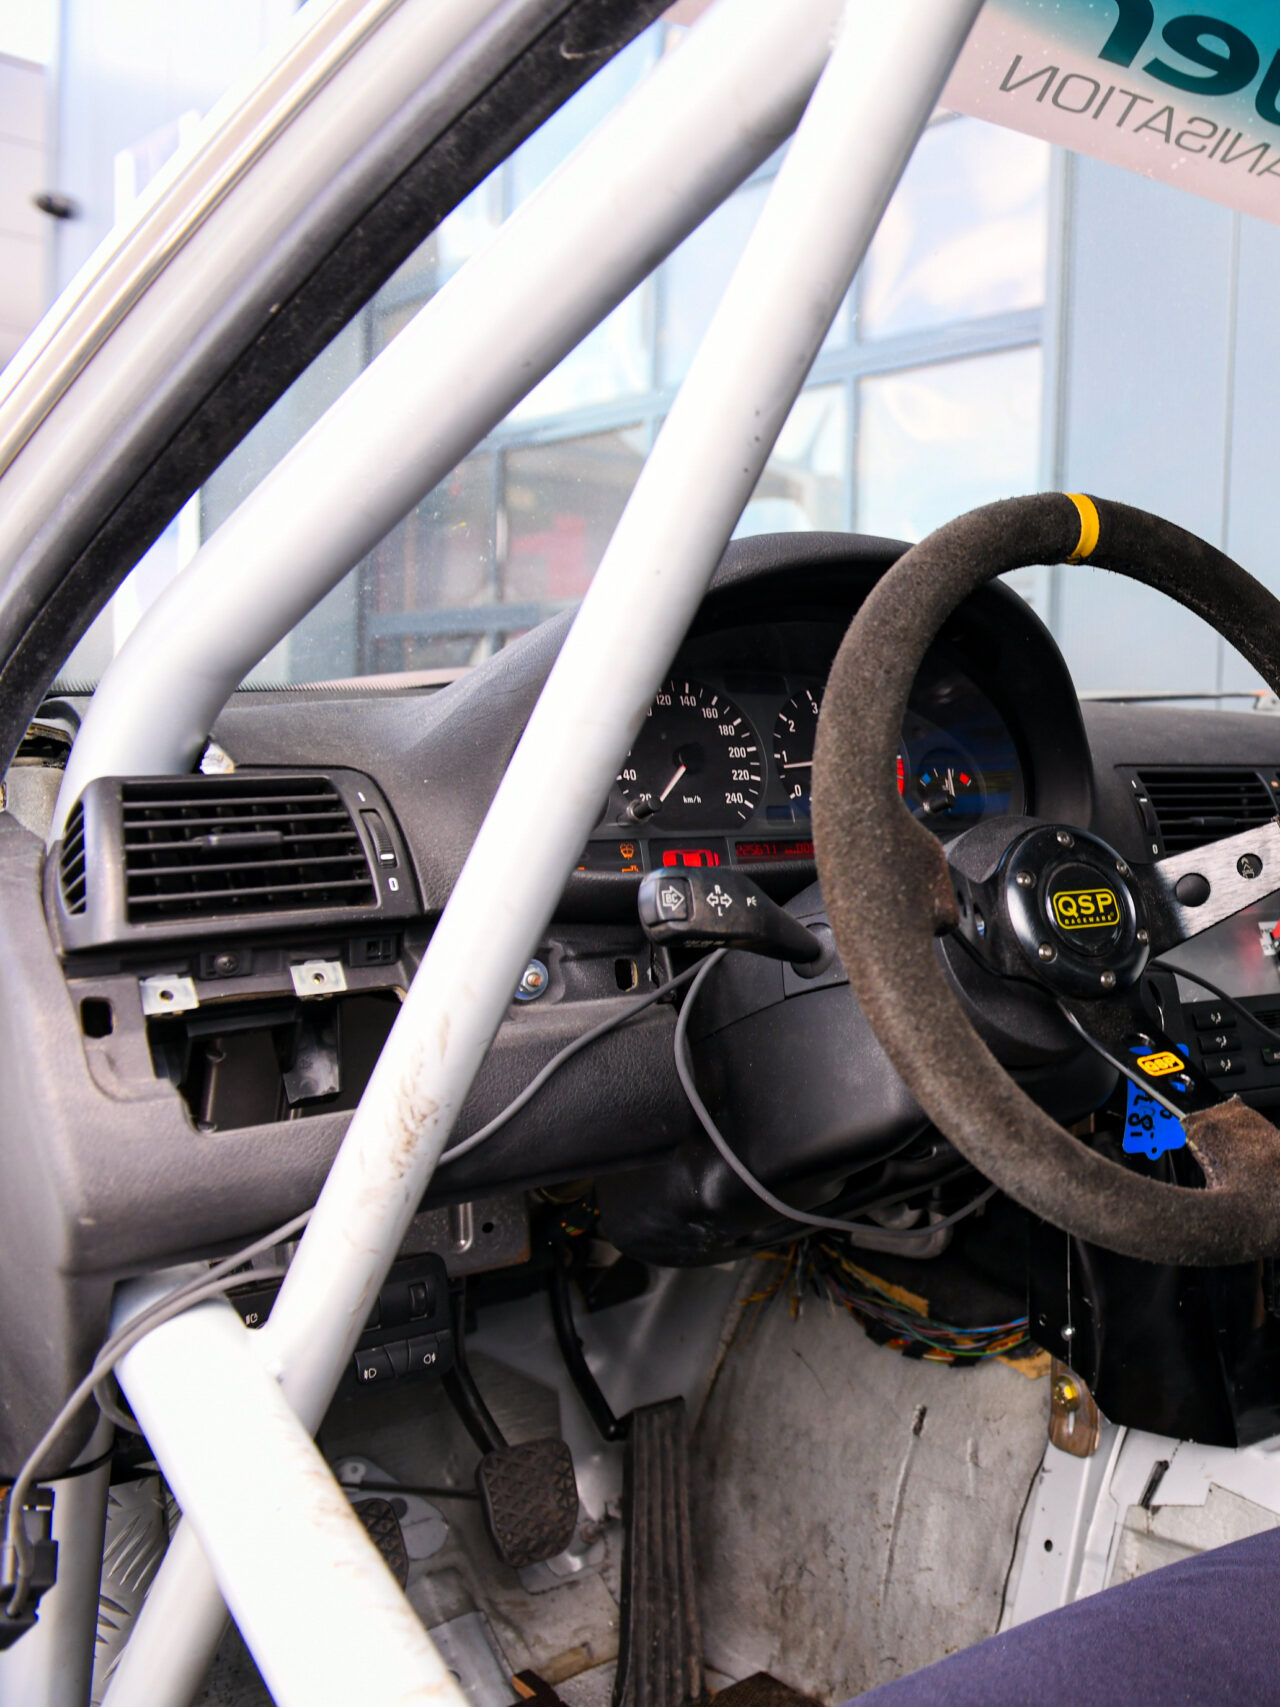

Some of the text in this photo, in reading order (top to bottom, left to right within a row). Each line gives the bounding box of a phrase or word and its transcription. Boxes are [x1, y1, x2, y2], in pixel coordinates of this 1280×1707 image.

[656, 694, 671, 706] 120
[680, 695, 697, 707] 140
[702, 708, 718, 720] 160
[718, 725, 735, 736] 180
[787, 719, 796, 732] 2
[728, 747, 747, 758] 200
[782, 750, 788, 763] 1
[622, 768, 637, 781] 40
[732, 770, 749, 781] 220
[794, 784, 802, 797] 0
[683, 795, 702, 804] km/h
[725, 792, 744, 804] 240
[714, 884, 721, 895] R
[665, 893, 678, 904] BC
[1057, 892, 1113, 918] QSP
[717, 906, 724, 917] L
